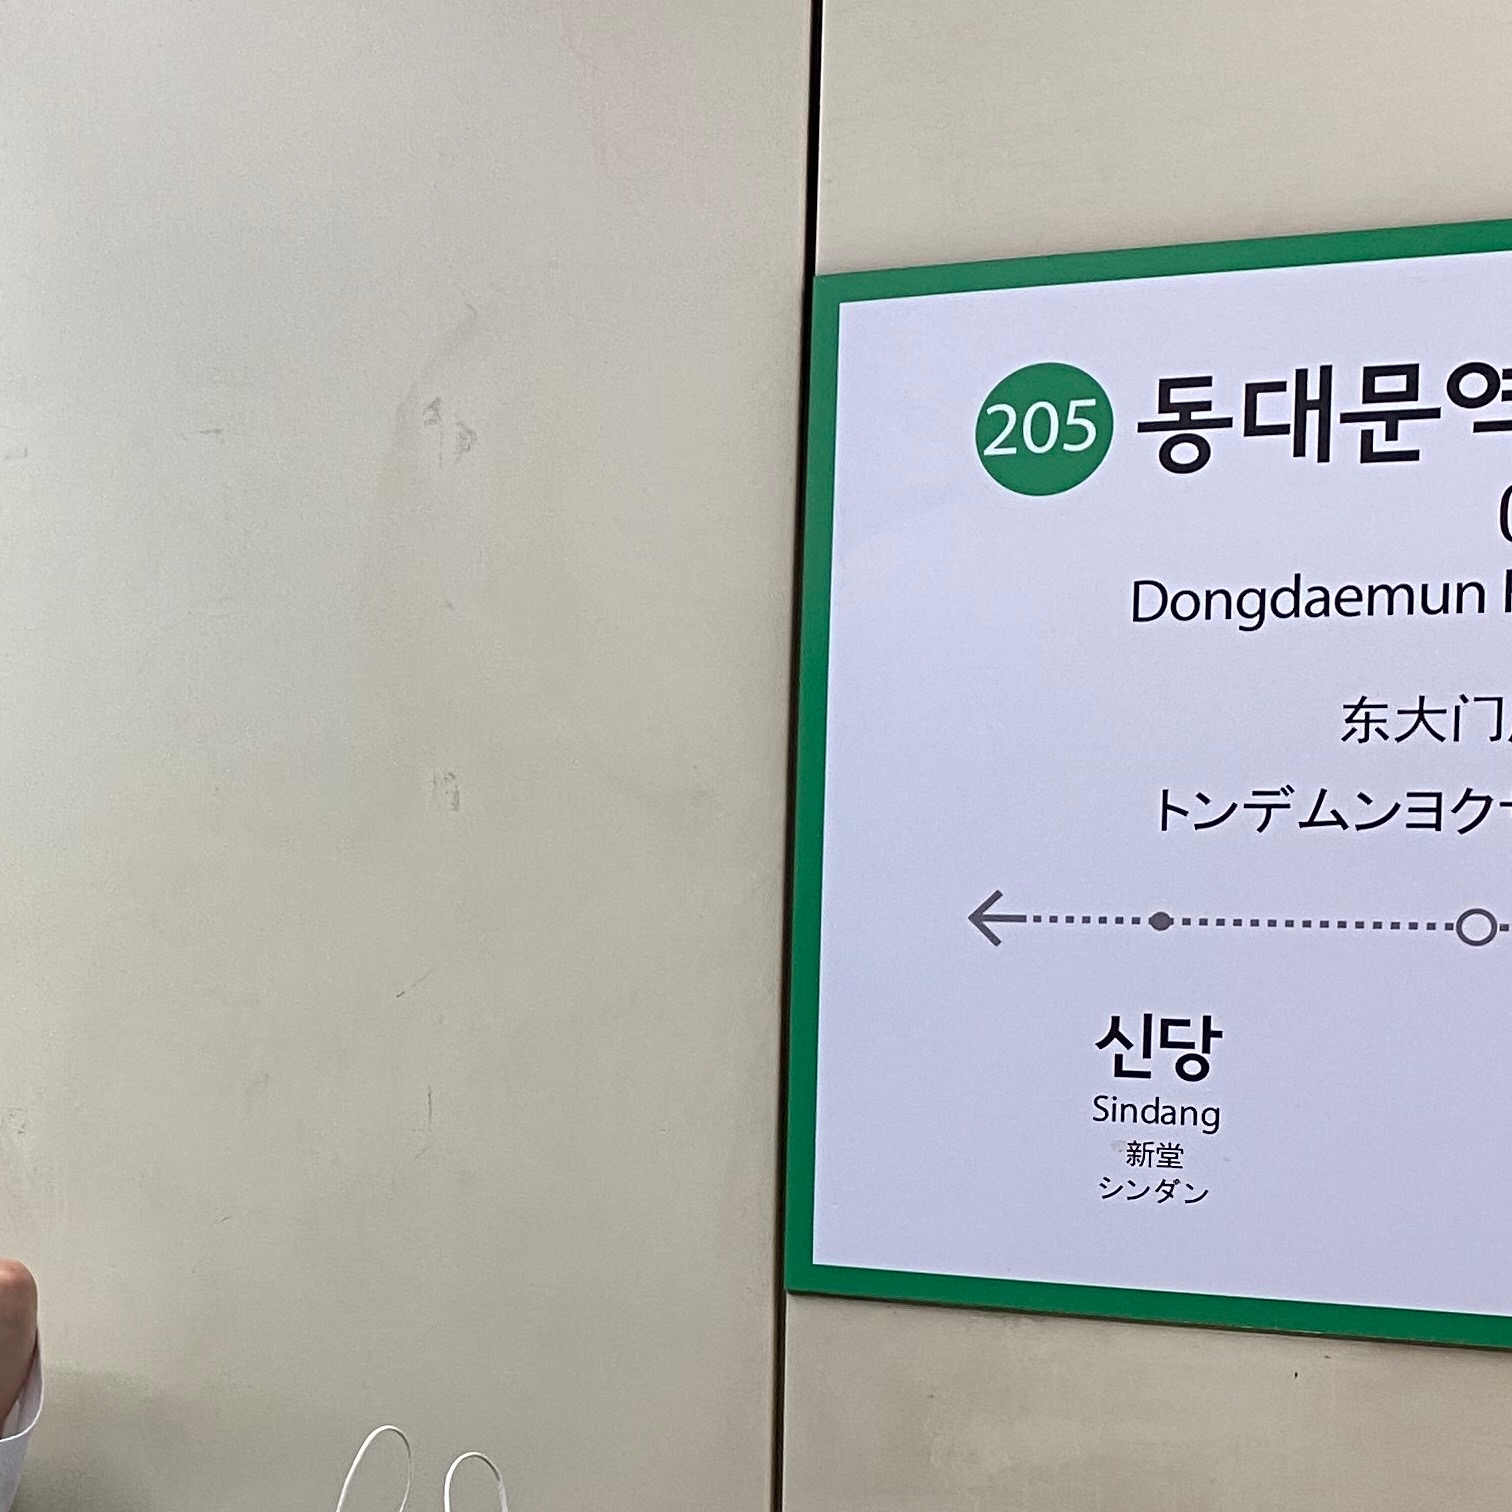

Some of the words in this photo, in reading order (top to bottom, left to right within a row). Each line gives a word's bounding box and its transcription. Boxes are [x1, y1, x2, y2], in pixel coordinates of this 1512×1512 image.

[981, 396, 1098, 458] 205
[1132, 572, 1486, 632] Dongdaemun
[1341, 694, 1512, 744] 东大门
[1094, 1013, 1224, 1083] 신당
[1092, 1094, 1222, 1135] Sindang
[1126, 1139, 1184, 1170] 新堂
[1099, 1176, 1209, 1205] シンダン
